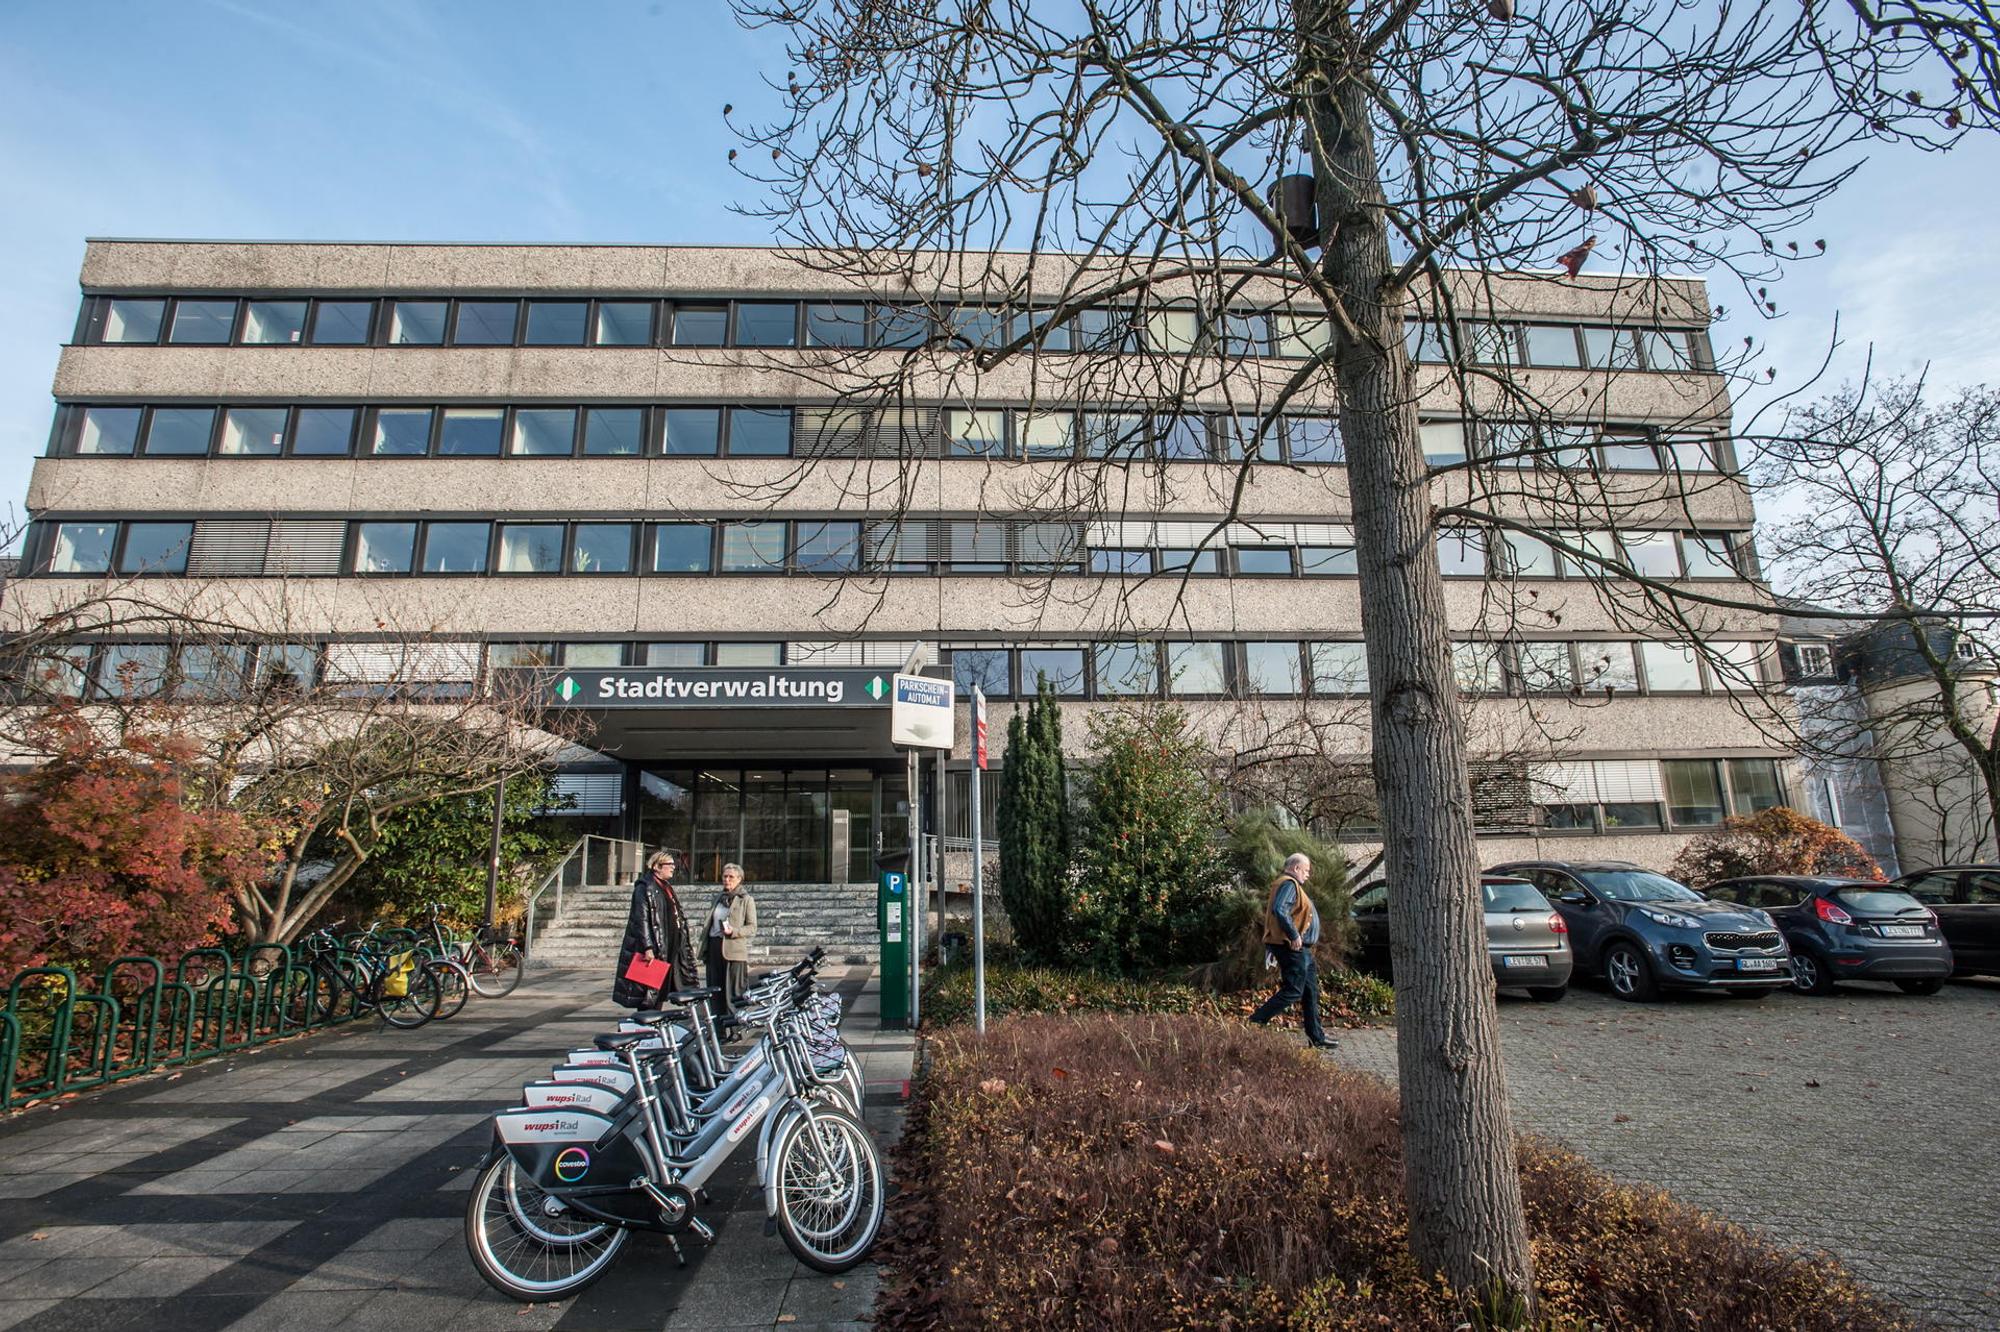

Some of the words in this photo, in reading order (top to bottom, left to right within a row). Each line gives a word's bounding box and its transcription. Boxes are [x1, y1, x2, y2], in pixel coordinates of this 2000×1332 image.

[598, 675, 844, 703] Stadtverwaltung
[899, 679, 949, 695] PARKSCHEIN-
[906, 691, 941, 705] AUTOMAT
[890, 875, 900, 891] P
